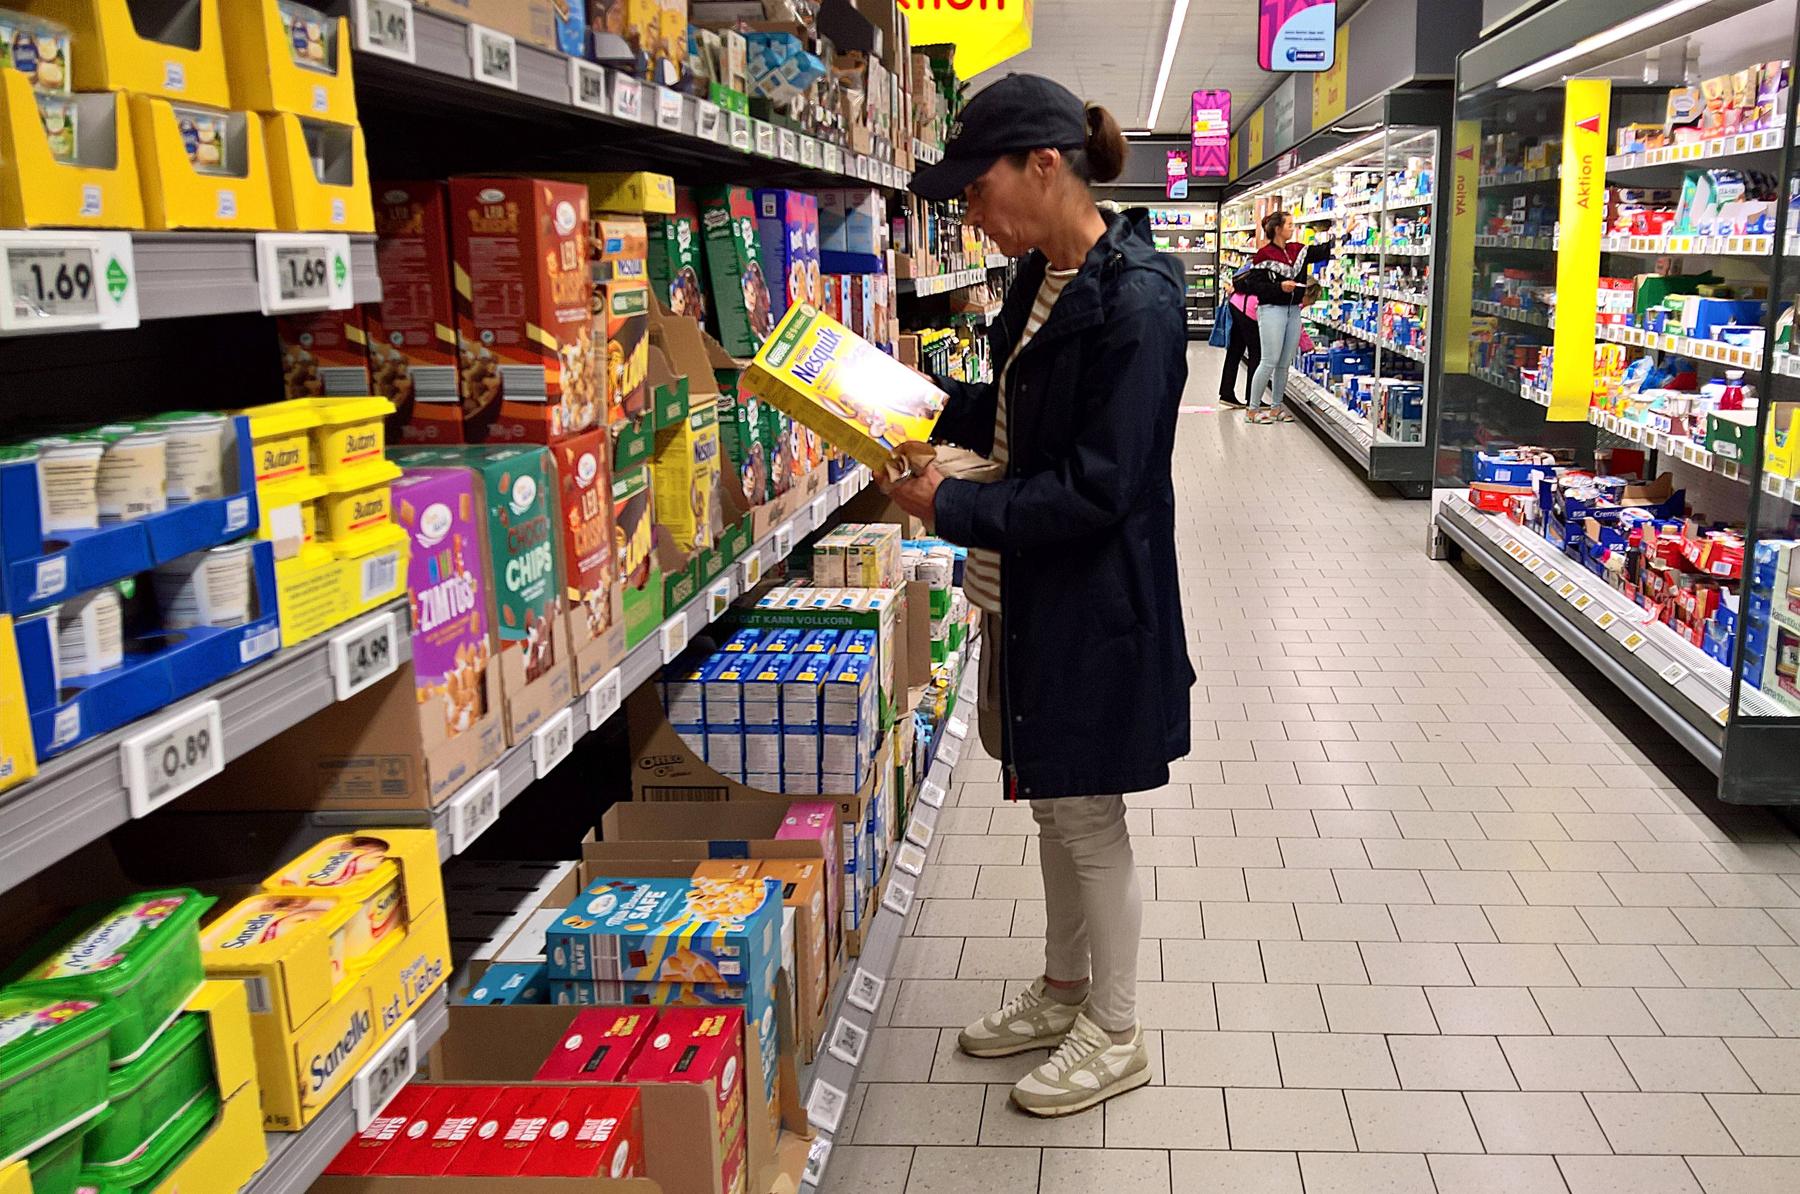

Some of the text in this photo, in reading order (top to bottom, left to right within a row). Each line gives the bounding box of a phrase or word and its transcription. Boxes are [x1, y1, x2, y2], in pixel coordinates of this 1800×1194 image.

[1577, 155, 1592, 209] Aktion
[31, 264, 91, 300] 1.69
[289, 259, 327, 287] 1.69
[791, 328, 843, 385] Nesquik
[506, 541, 552, 591] CHIPS
[763, 615, 794, 625] KANN
[795, 616, 853, 625] VOLLKORN
[357, 635, 389, 667] 4.99
[163, 729, 210, 777] 0.89
[308, 851, 353, 879] Sanella
[628, 891, 667, 919] SAFE
[220, 913, 275, 948] Sanella
[383, 958, 442, 1031] ist Liebe
[310, 1009, 370, 1091] Sanella
[380, 1046, 408, 1093] 2.19
[376, 1116, 407, 1140] BITS
[448, 1116, 478, 1141] BITS
[519, 1117, 548, 1142] BITS
[591, 1117, 618, 1142] BITS
